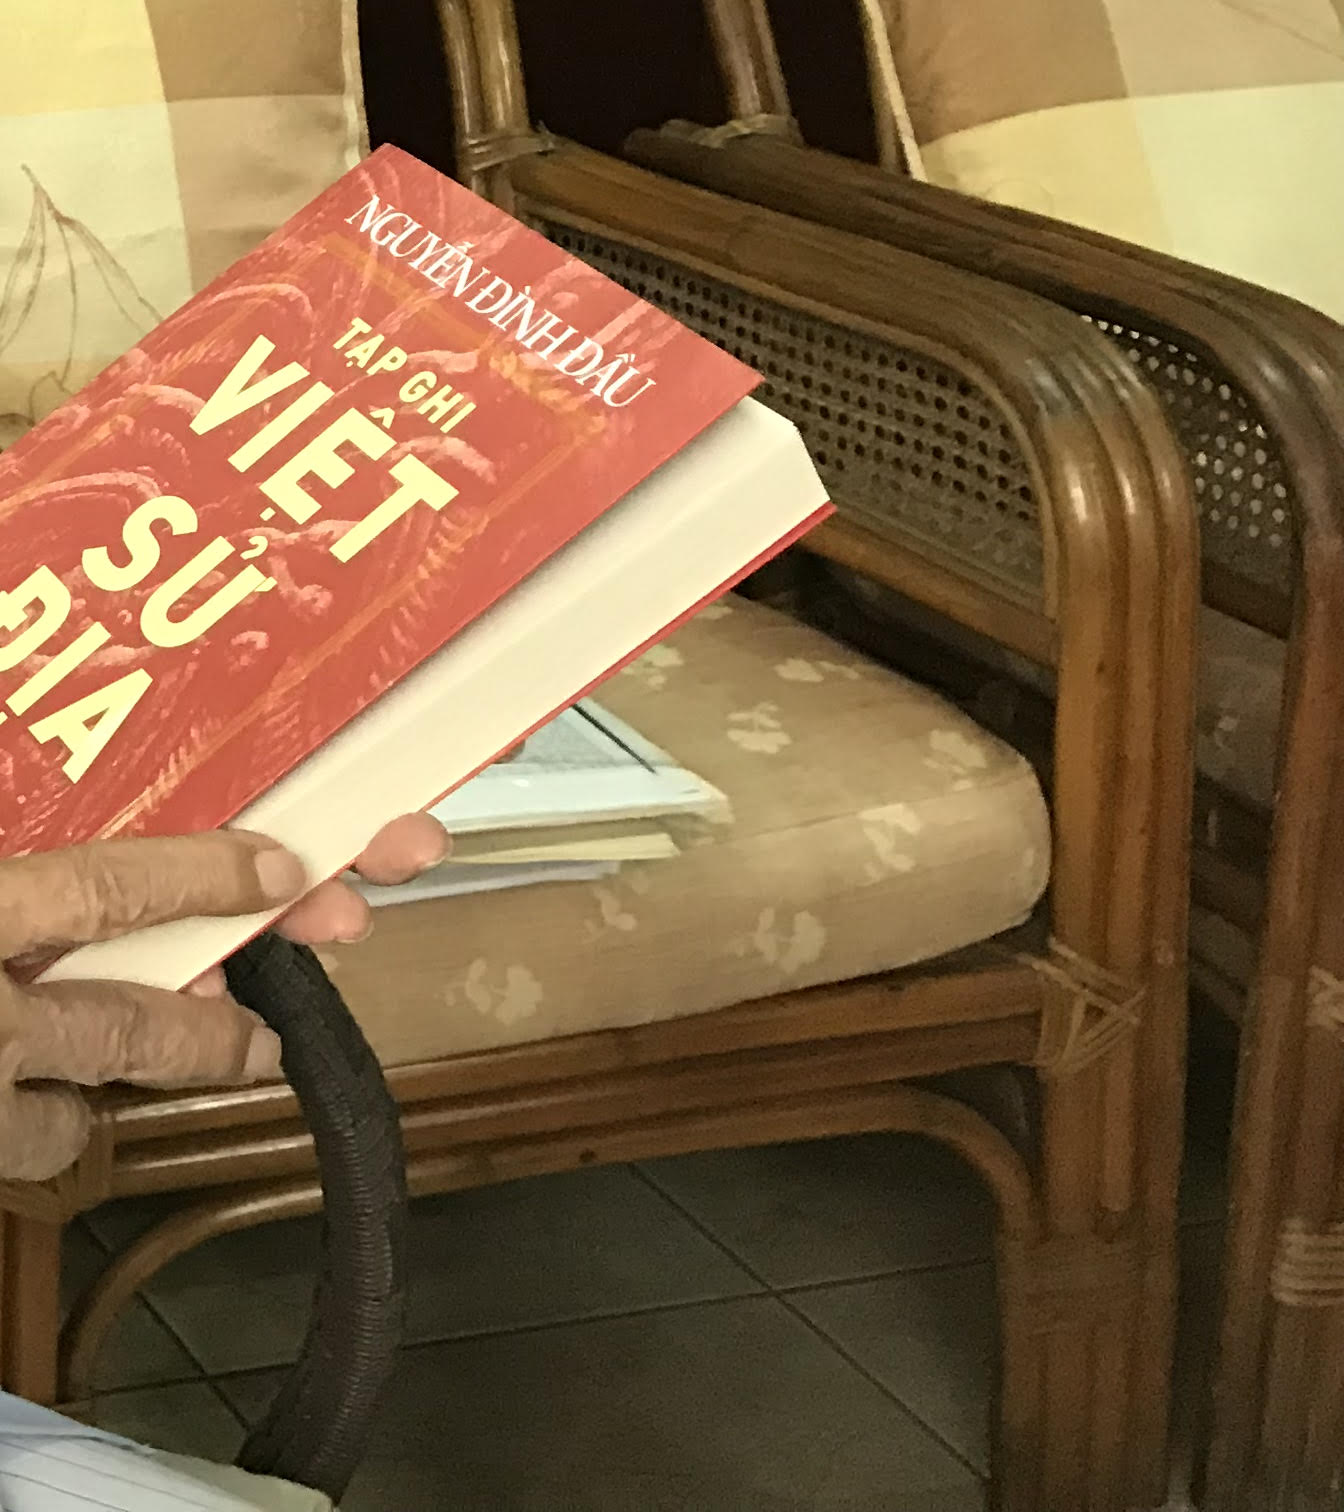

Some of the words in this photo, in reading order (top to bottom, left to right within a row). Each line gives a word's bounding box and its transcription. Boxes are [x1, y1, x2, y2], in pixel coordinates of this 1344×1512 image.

[333, 317, 408, 376] TẠP
[399, 370, 477, 434] GHI
[343, 194, 491, 298] NGUYỄN
[465, 275, 579, 361] ĐÌNH
[554, 336, 657, 408] ĐẦU
[189, 334, 460, 563] VIỆT
[81, 495, 278, 648] SỬ
